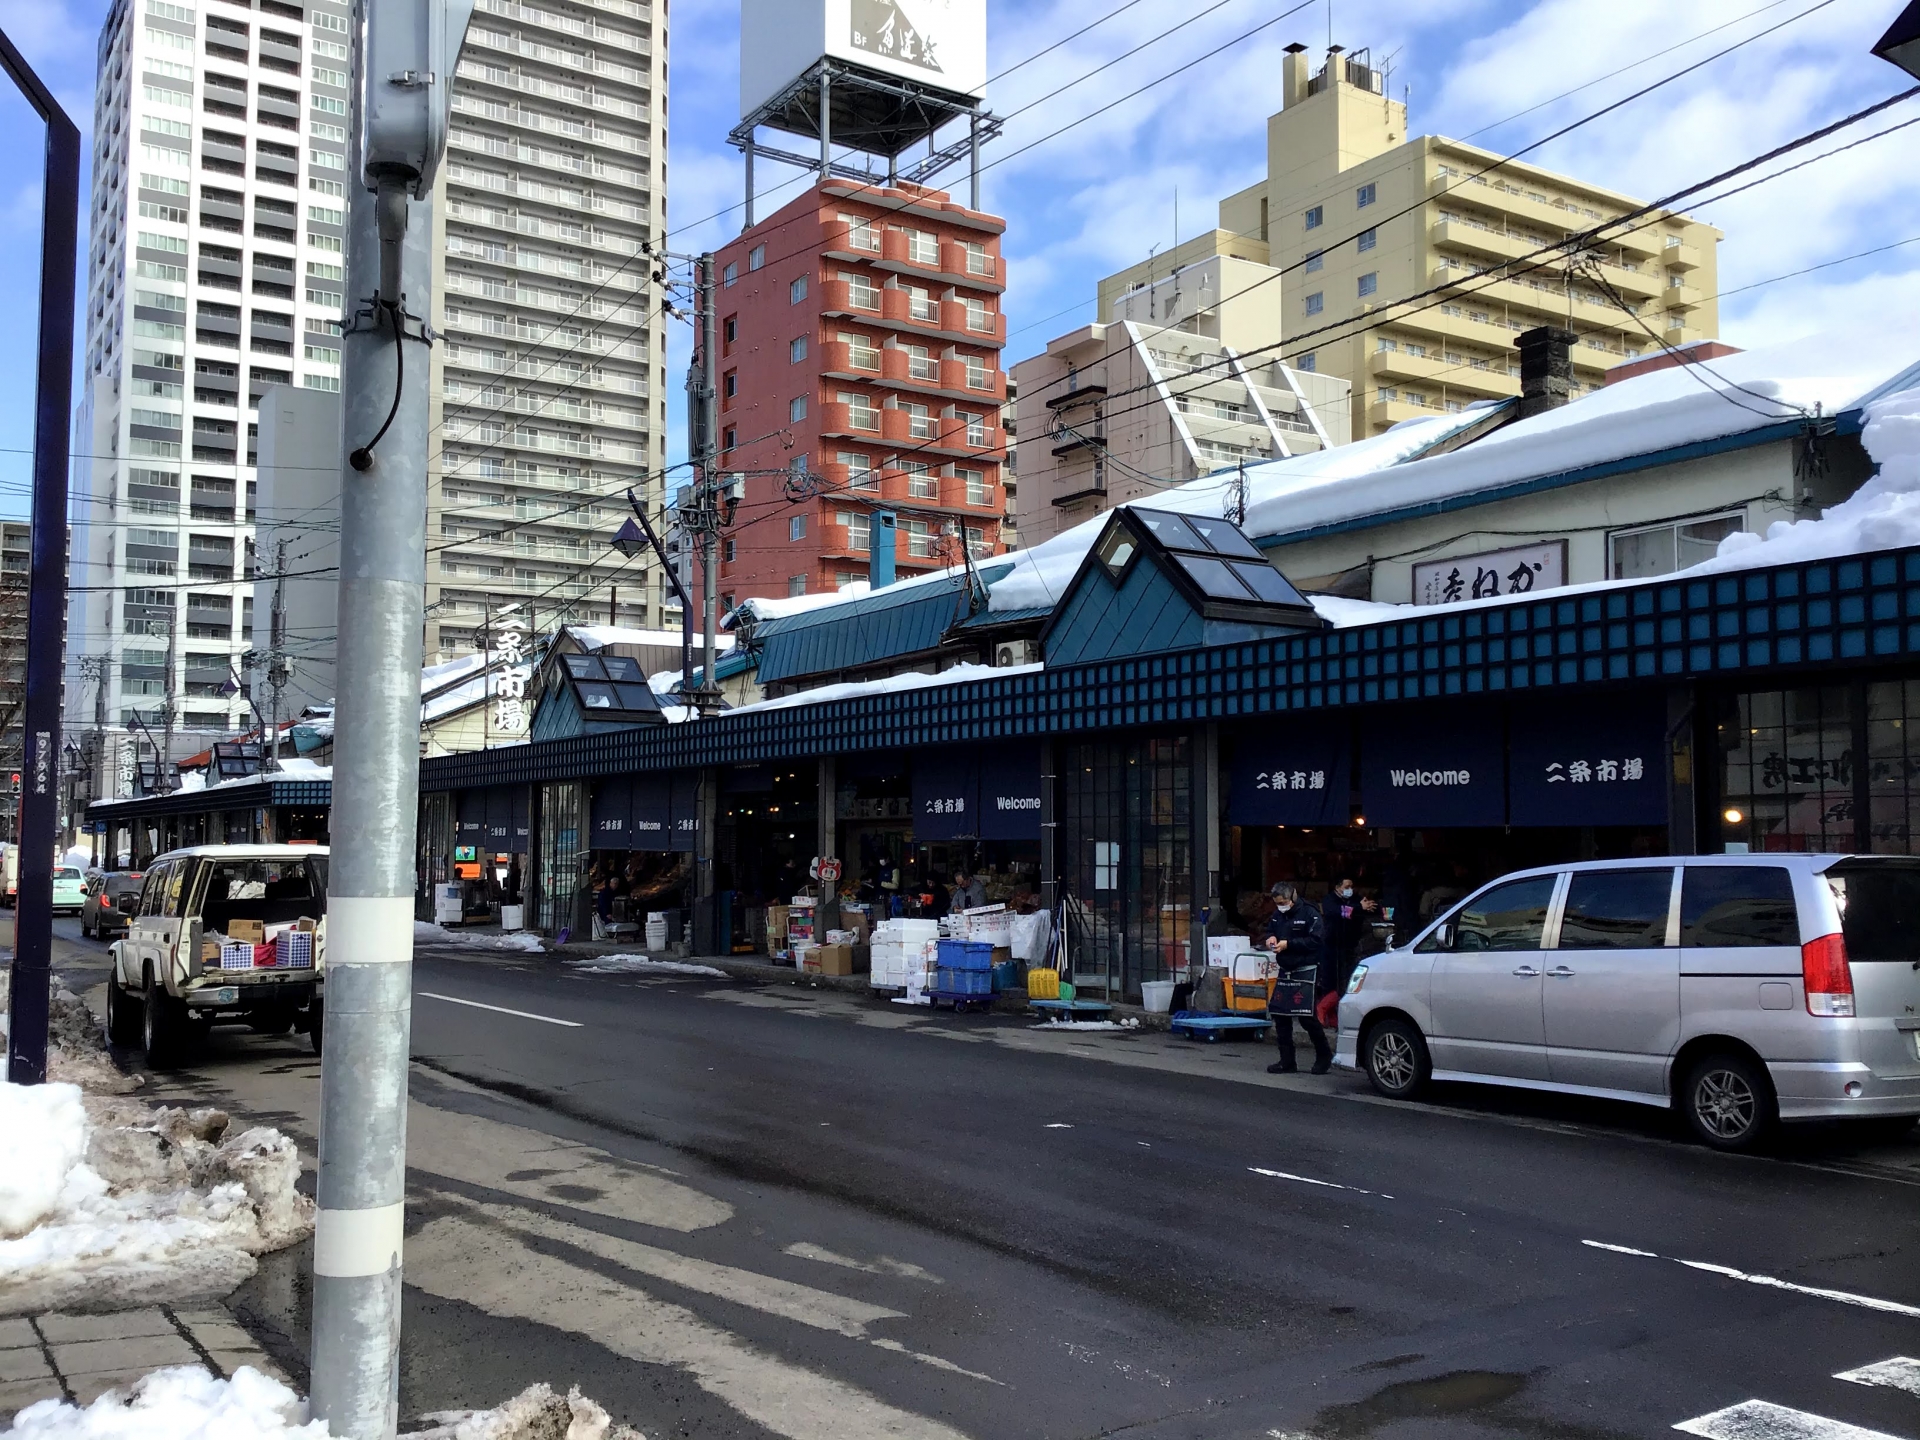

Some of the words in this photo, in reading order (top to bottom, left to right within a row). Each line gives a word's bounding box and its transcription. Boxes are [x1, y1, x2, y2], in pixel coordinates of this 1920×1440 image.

[496, 603, 526, 730] 二条市場
[36, 739, 47, 794] 97964
[118, 737, 135, 796] 二条市場
[1545, 757, 1644, 783] 二条市場
[1256, 770, 1325, 790] 二条市場
[1390, 768, 1470, 788] Welcome
[925, 797, 965, 814] 二条市場
[997, 796, 1041, 811] Welcome
[638, 820, 662, 831] Welcome
